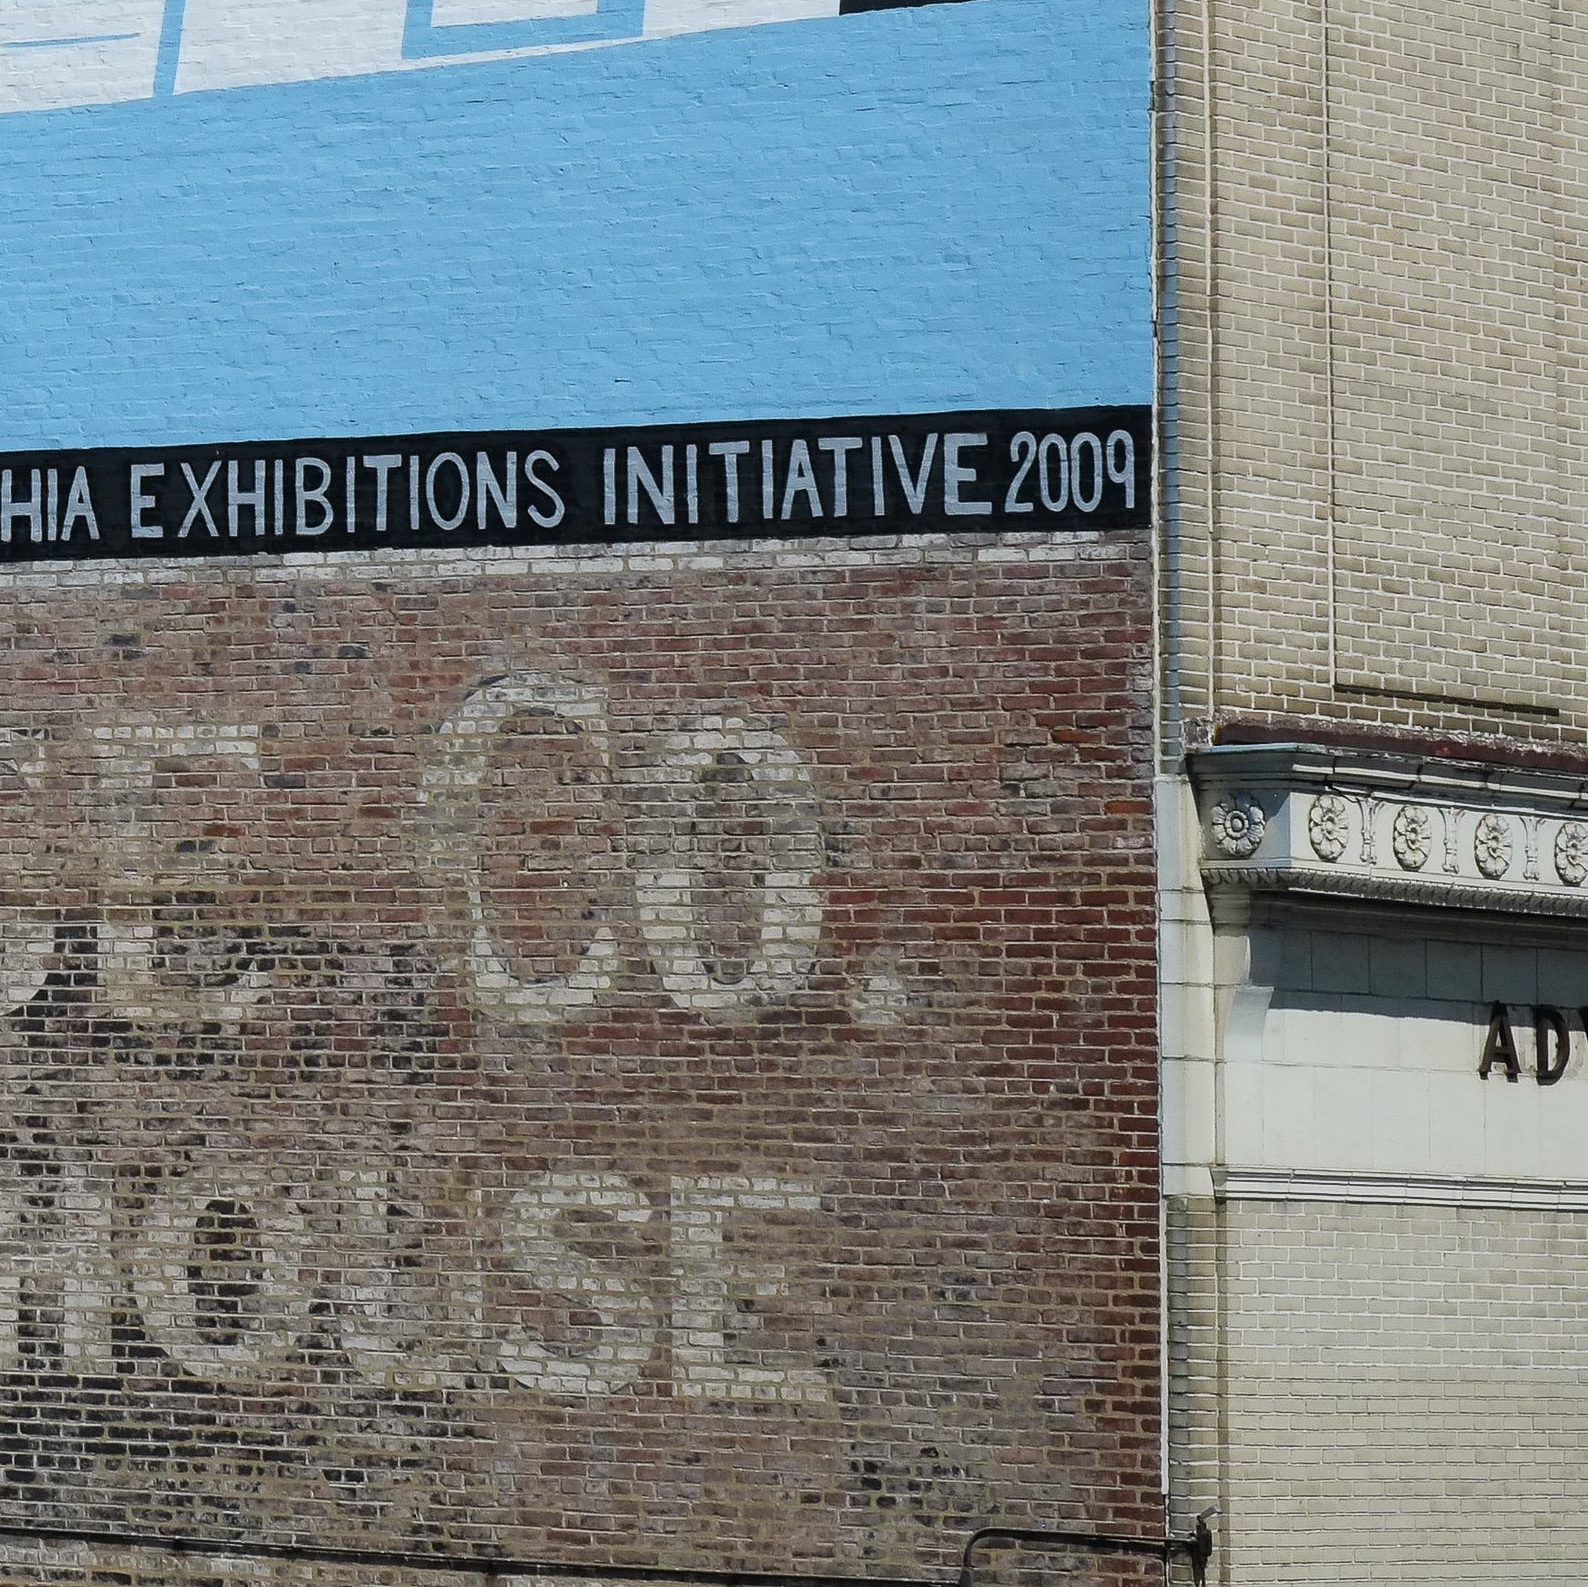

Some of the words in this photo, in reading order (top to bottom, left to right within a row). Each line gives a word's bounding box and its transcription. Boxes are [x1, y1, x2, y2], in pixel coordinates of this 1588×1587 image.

[130, 449, 565, 538] EXHIBITIONS
[603, 432, 993, 525] INITIATIVE
[1004, 429, 1135, 513] 2009
[1476, 1000, 1588, 1086] AD
